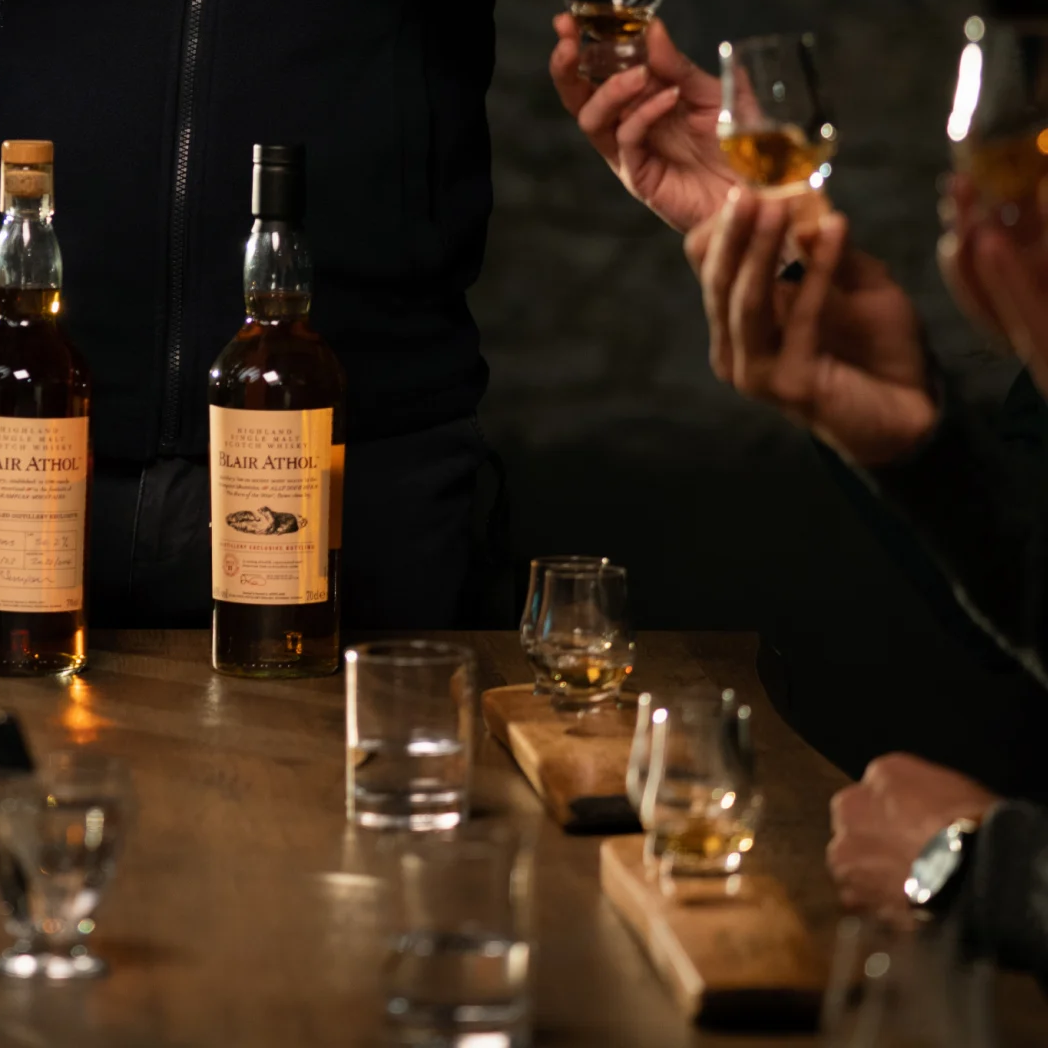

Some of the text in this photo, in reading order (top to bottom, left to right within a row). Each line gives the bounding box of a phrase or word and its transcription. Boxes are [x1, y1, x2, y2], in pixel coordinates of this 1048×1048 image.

[25, 455, 79, 472] ATHOL
[219, 451, 317, 470] BLAIR ATHOL
